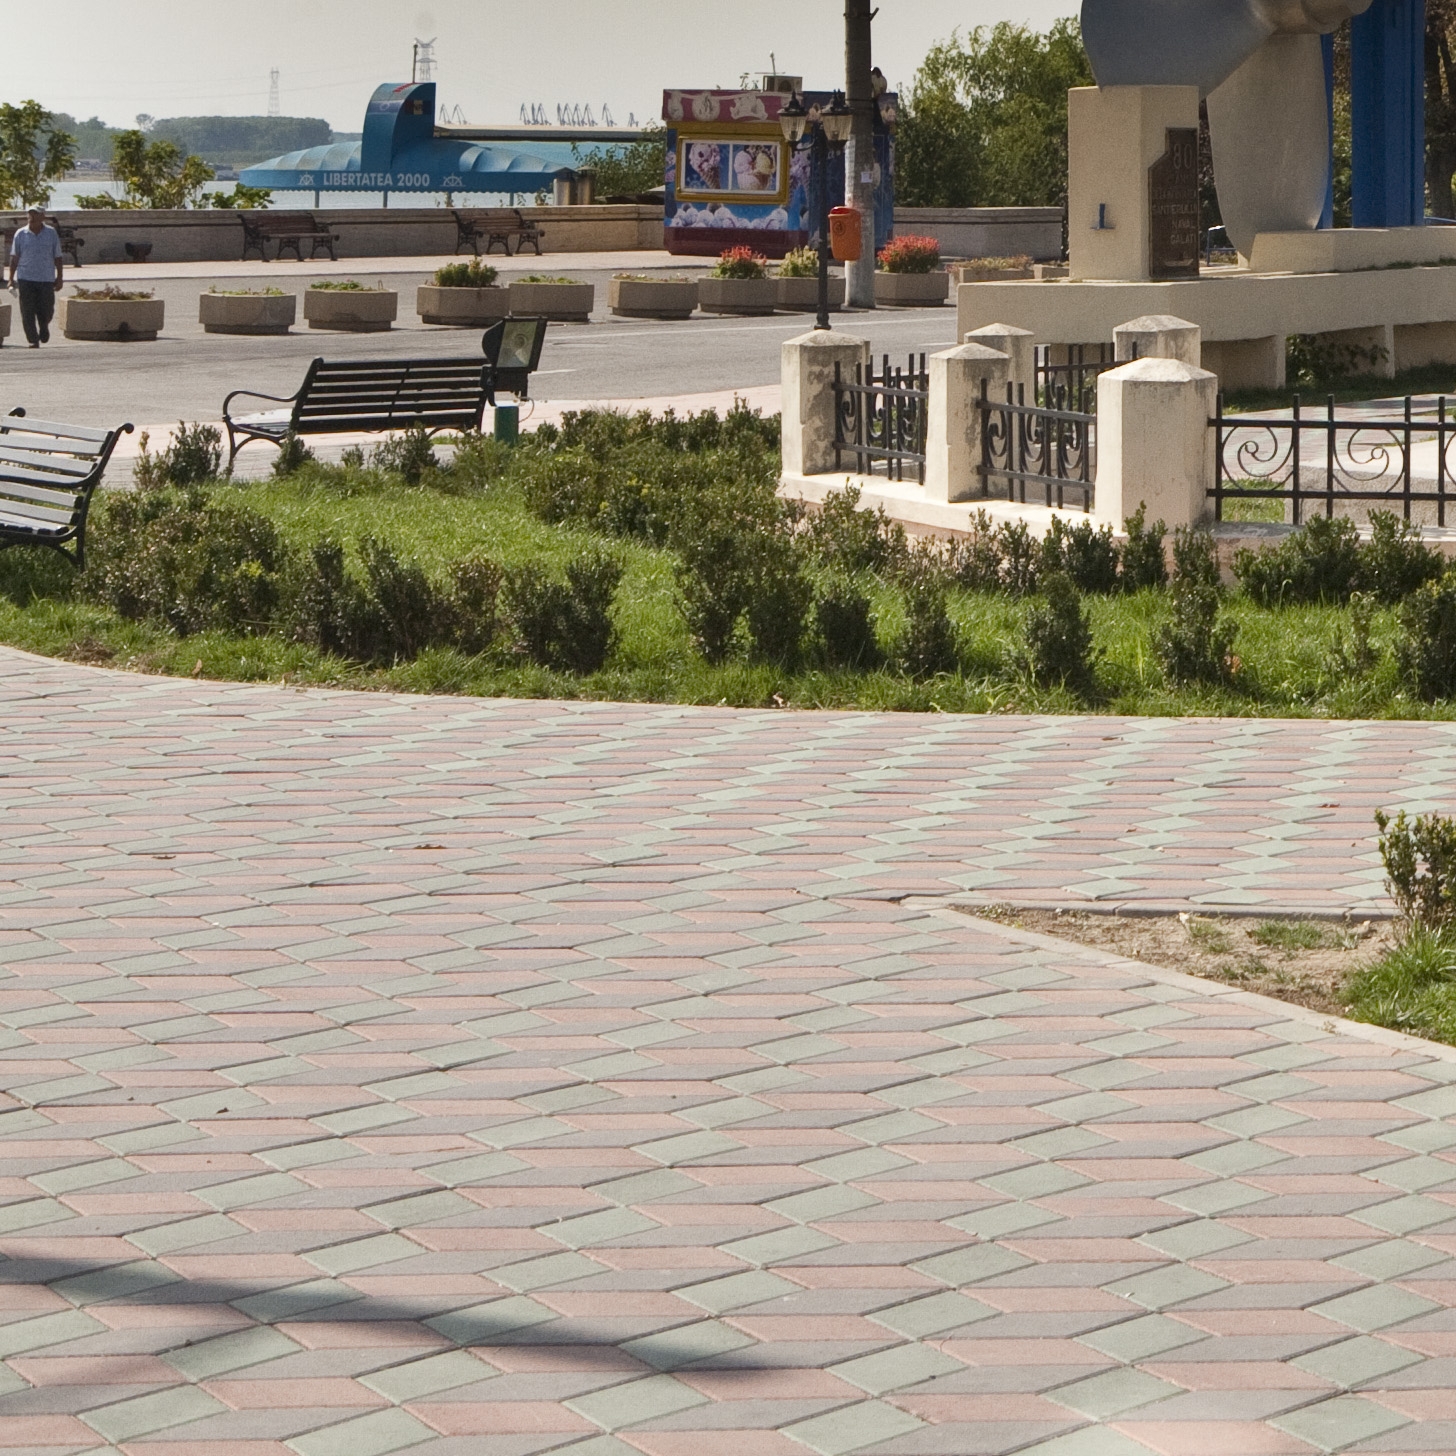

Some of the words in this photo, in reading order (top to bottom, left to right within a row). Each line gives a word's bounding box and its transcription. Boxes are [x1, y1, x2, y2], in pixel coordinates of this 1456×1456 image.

[1174, 144, 1192, 169] 80
[323, 173, 393, 186] LIBERTATEA
[397, 173, 430, 186] 2000
